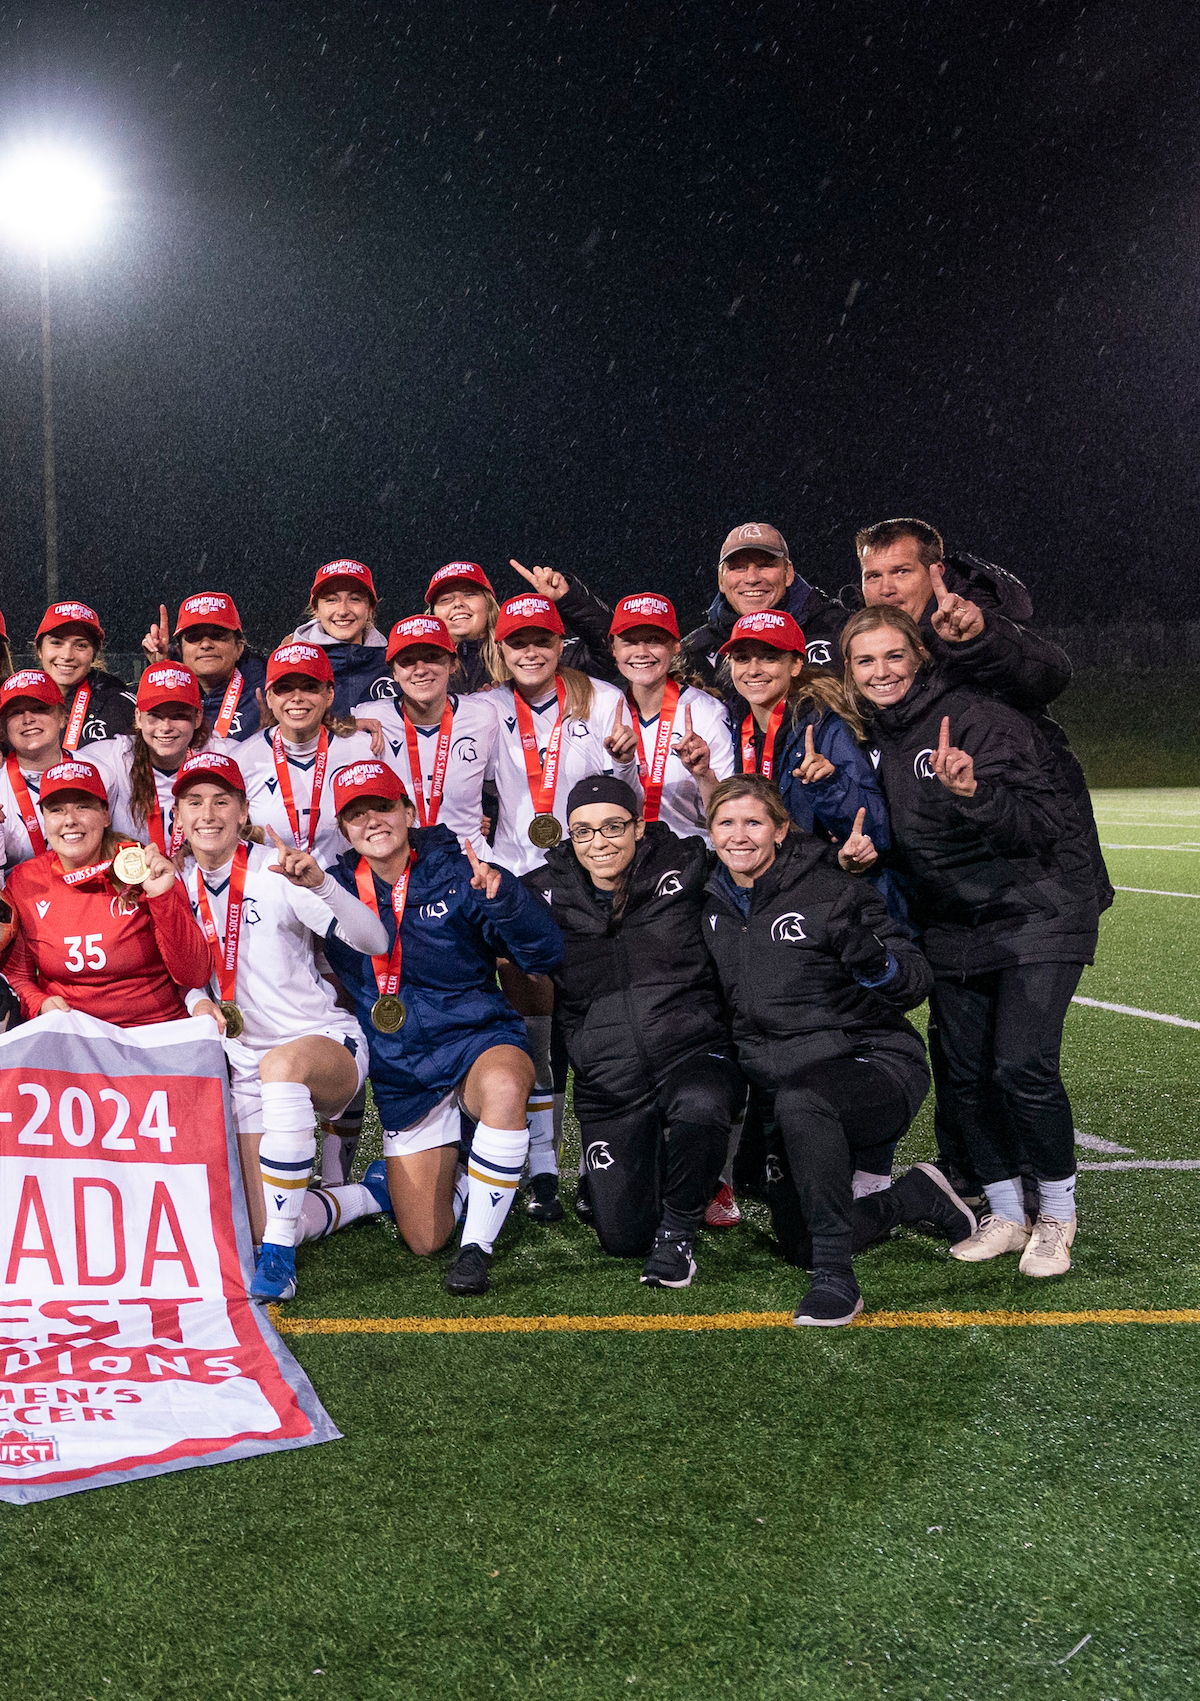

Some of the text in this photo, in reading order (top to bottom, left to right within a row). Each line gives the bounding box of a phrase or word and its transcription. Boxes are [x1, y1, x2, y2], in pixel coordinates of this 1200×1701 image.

[185, 597, 226, 611] CHAMPIONS
[506, 598, 549, 614] CHAMPIONS
[623, 598, 668, 613] CHAMPIONS
[397, 619, 440, 634] CHAMPIONS
[738, 613, 784, 628] CHAMPIONS
[274, 645, 318, 661] CHAMPIONS
[4, 672, 45, 690] CHAMPIONS
[148, 669, 191, 684] CHAMPIONS
[66, 690, 88, 745] WOMEN'S SOCCER
[544, 726, 561, 789] WOMEN'S SOCCER
[652, 720, 671, 783] WOMEN'S SOCCER
[47, 763, 92, 779] CHAMPIONS
[183, 753, 229, 771] CHAMPIONS
[433, 735, 449, 797] WOMEN'S SOCCER
[338, 764, 383, 786] CHAMPIONS
[226, 903, 240, 971] WOMEN'S SOCCER
[64, 933, 107, 972] 35
